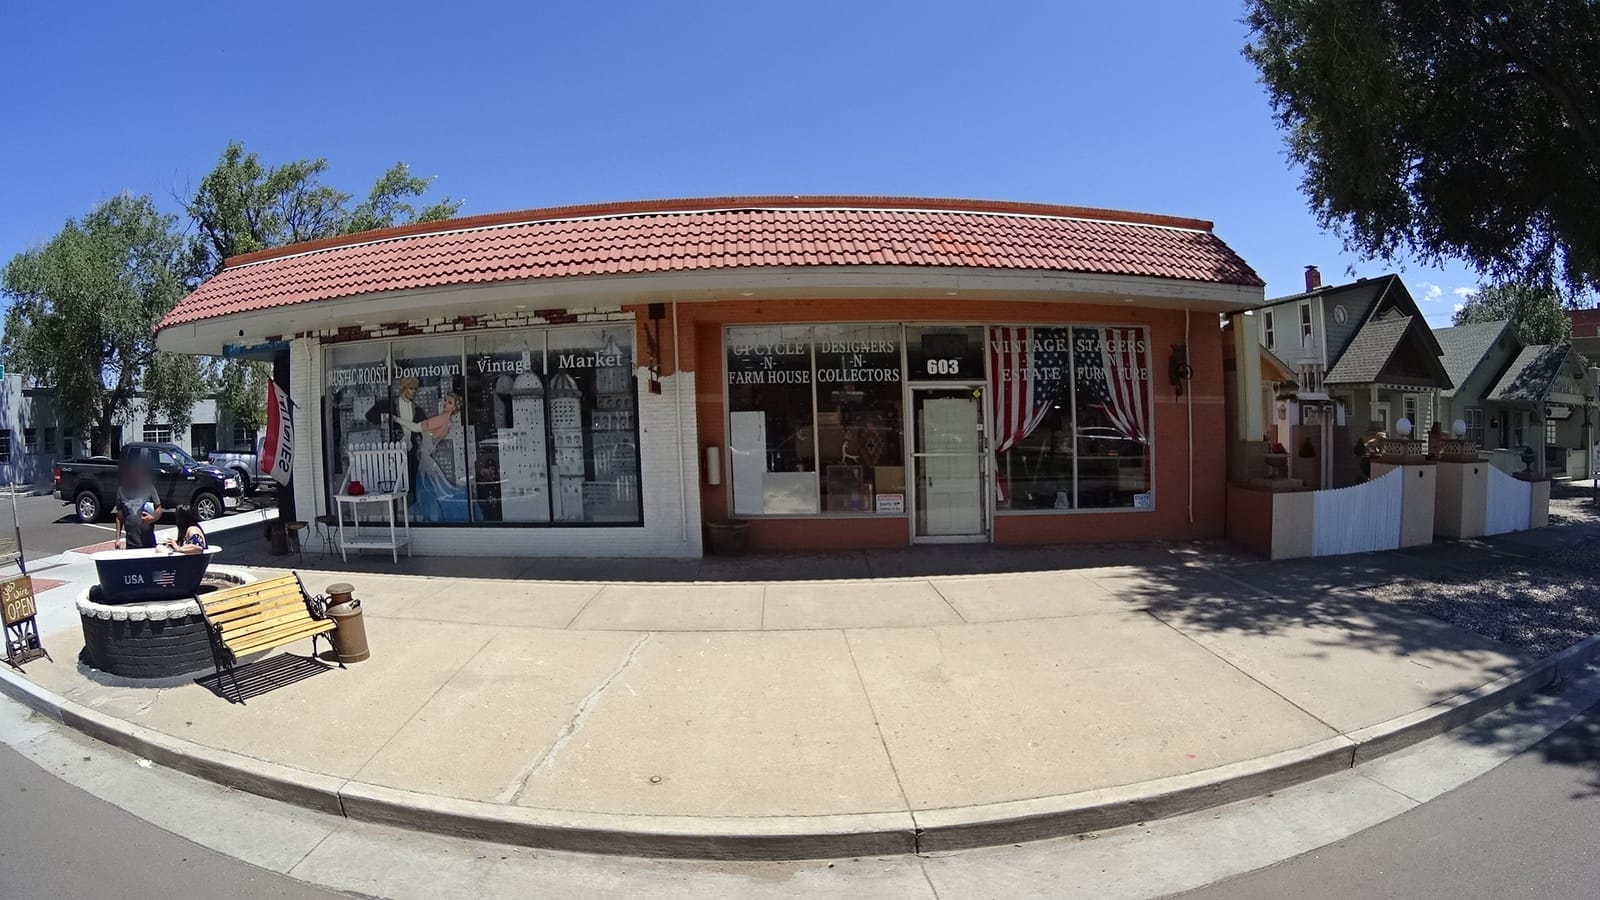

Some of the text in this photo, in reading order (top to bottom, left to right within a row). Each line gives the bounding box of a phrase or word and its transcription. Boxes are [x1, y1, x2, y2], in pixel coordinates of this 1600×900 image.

[733, 343, 805, 356] UPCYCLE
[822, 340, 894, 353] DESIGNERS
[991, 339, 1068, 353] VINTAGE
[1077, 339, 1145, 353] STAGERS
[358, 366, 386, 385] ROOST
[394, 364, 460, 379] Downtown
[476, 359, 531, 374] Vintage
[558, 351, 623, 369] Market
[927, 359, 959, 375] 603
[1002, 367, 1061, 381] ESTATE
[728, 370, 810, 384] FARM HOUSE
[817, 368, 900, 382] COLLECTORS
[123, 574, 145, 585] USA
[7, 596, 35, 620] OPEN
